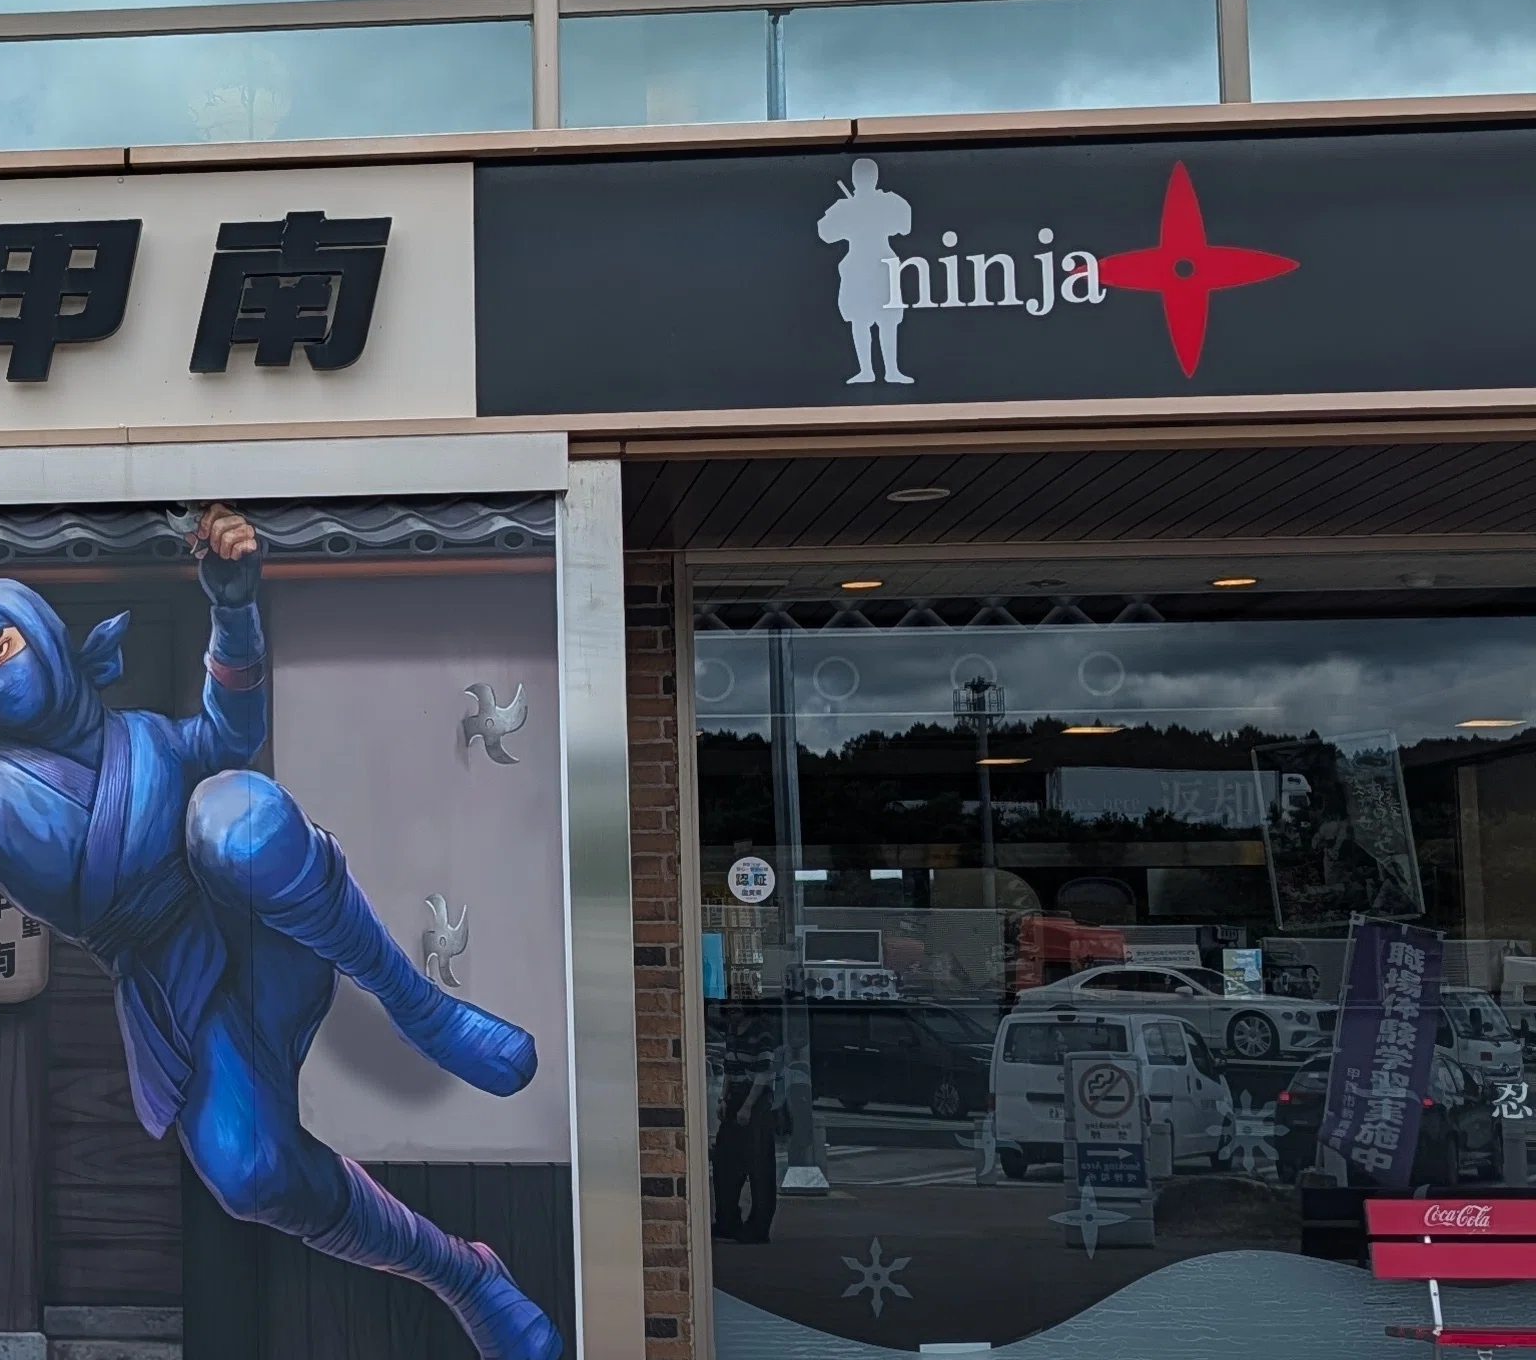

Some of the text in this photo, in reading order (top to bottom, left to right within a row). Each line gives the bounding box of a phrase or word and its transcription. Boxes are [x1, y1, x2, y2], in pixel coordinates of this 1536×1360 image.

[880, 227, 1107, 317] ninja
[1492, 1082, 1533, 1119] 忍
[1424, 1204, 1493, 1228] Coca-Cola
